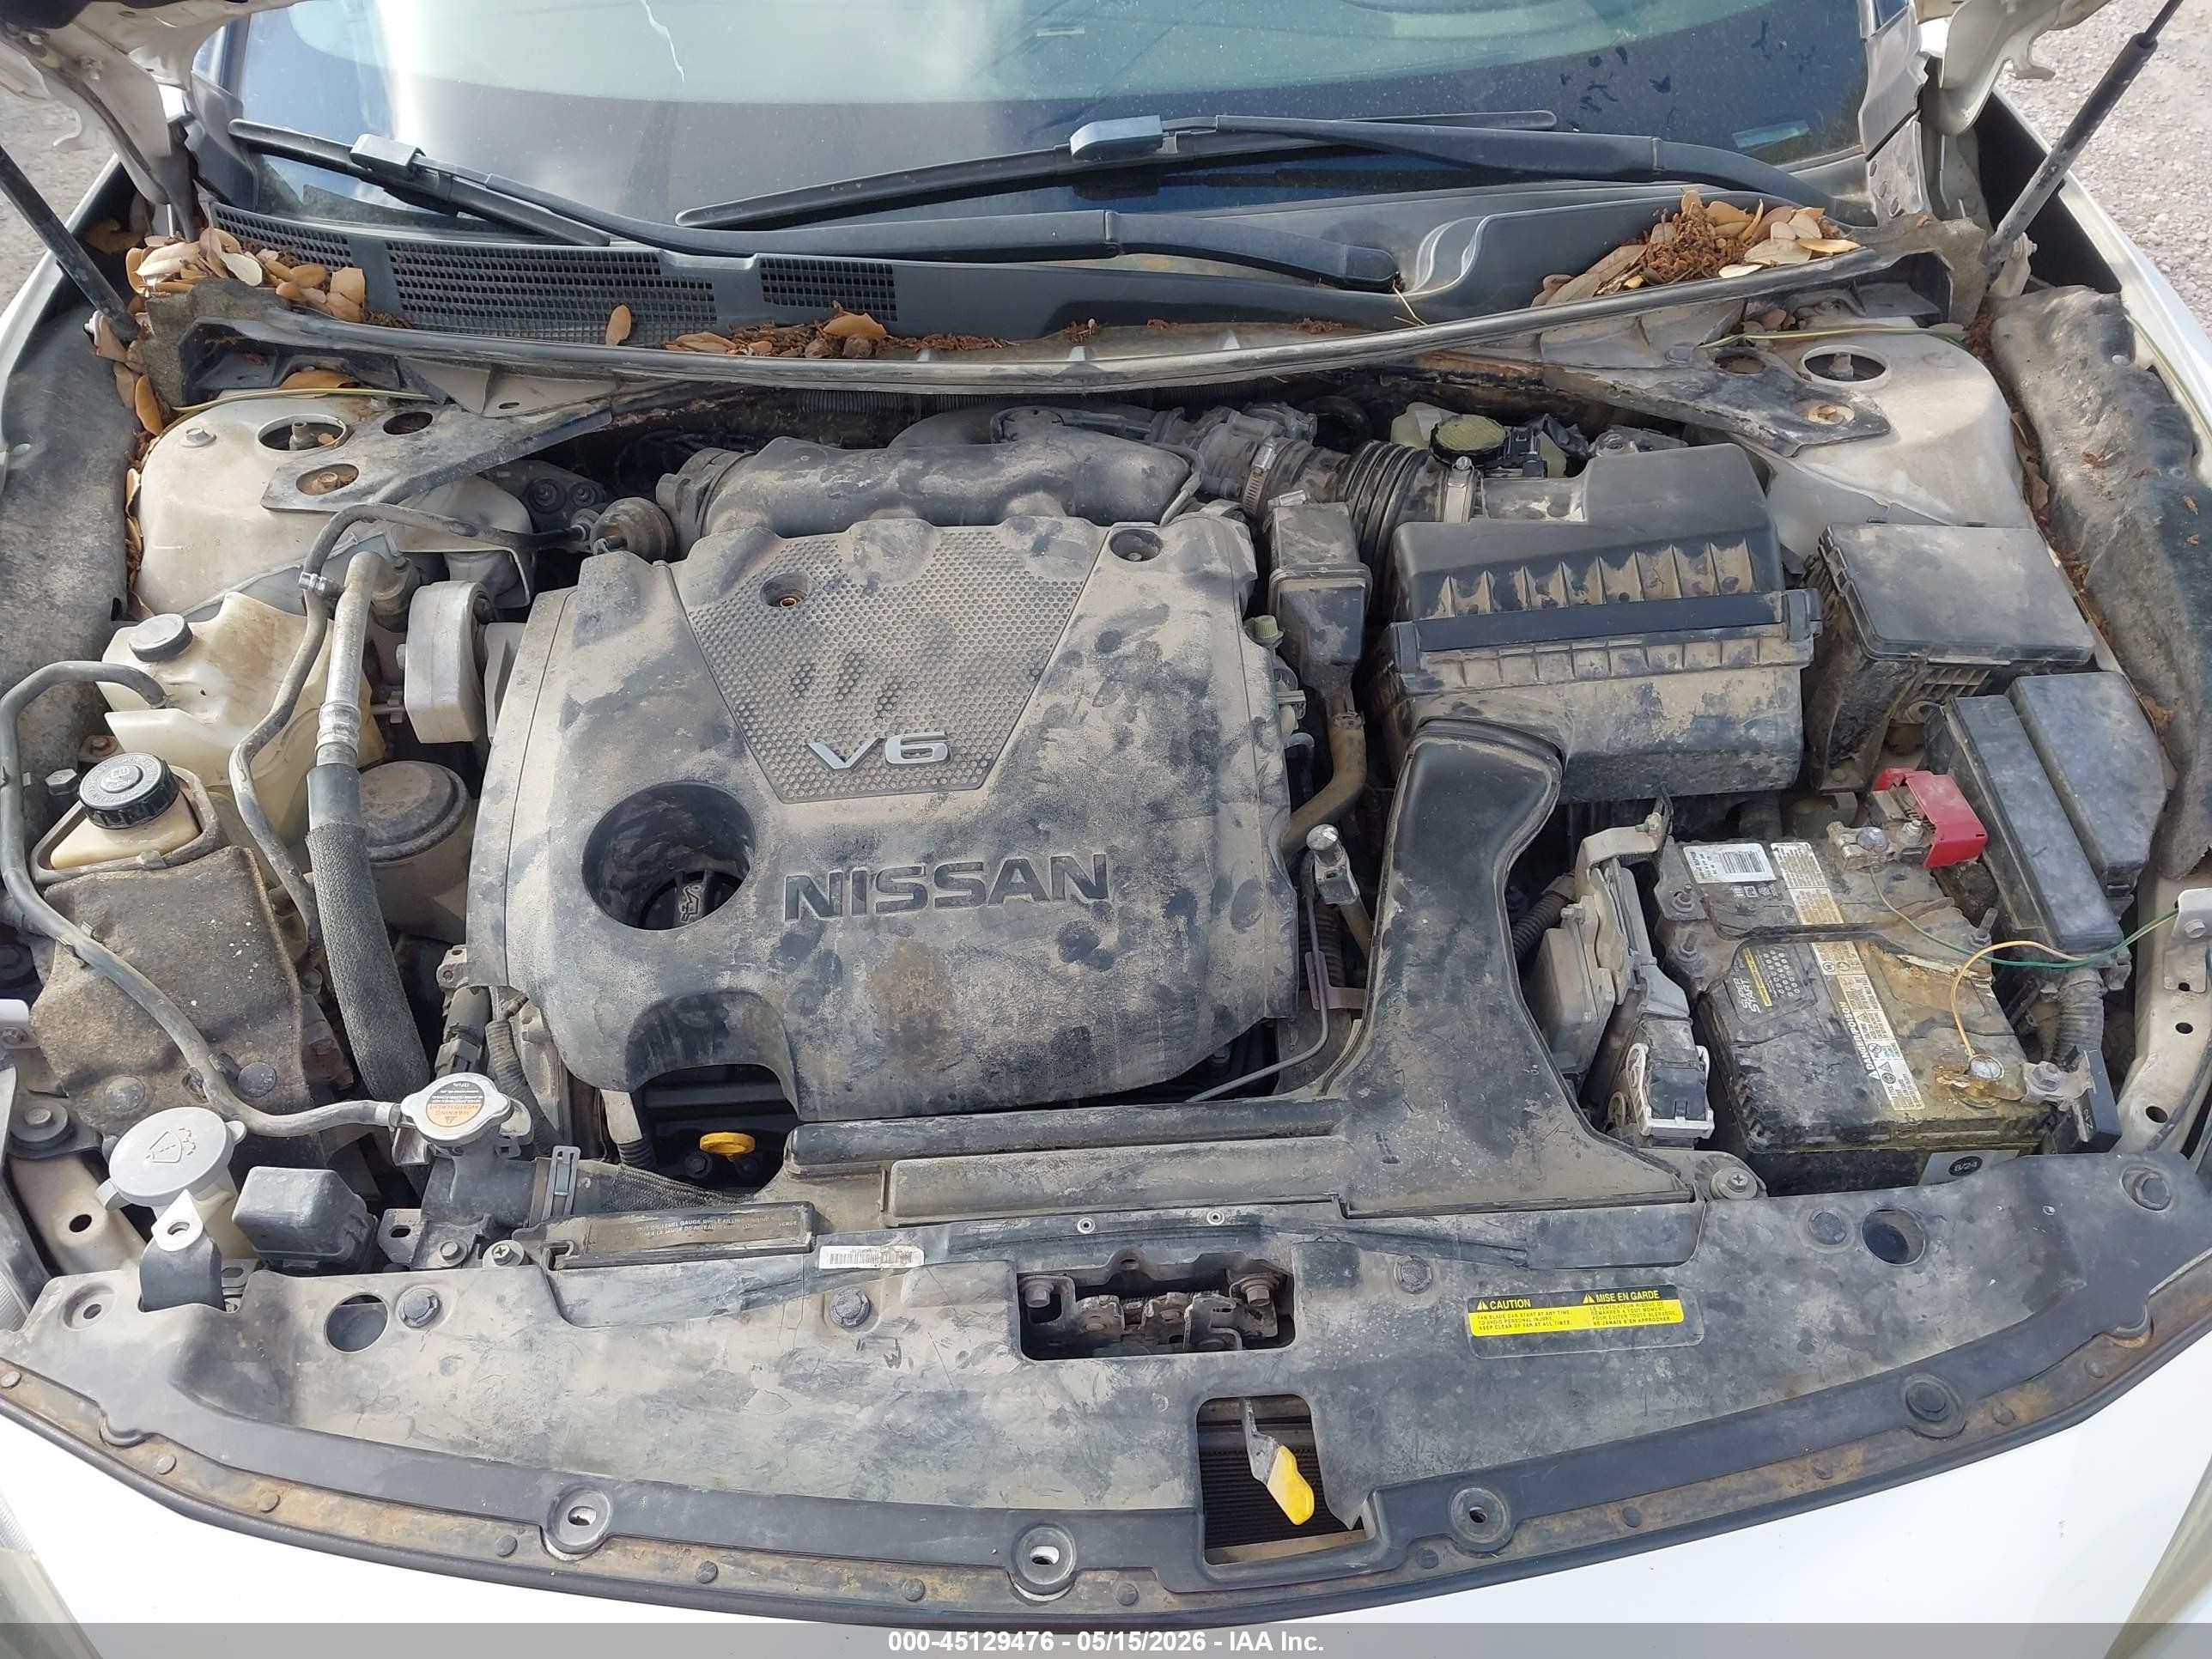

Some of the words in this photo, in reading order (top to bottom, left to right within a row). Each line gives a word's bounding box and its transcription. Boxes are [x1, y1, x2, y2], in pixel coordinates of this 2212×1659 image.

[807, 732, 951, 770] V6
[783, 854, 1109, 922] NISSAN
[1733, 977, 1748, 1009] SUPER
[1740, 978, 1761, 1013] START
[1839, 1001, 1876, 1071] DANGER/POISON
[1490, 1298, 1531, 1310] CAUTION
[1596, 1292, 1616, 1303] MISE
[1618, 1291, 1630, 1301] EN
[1631, 1290, 1660, 1300] GARDE
